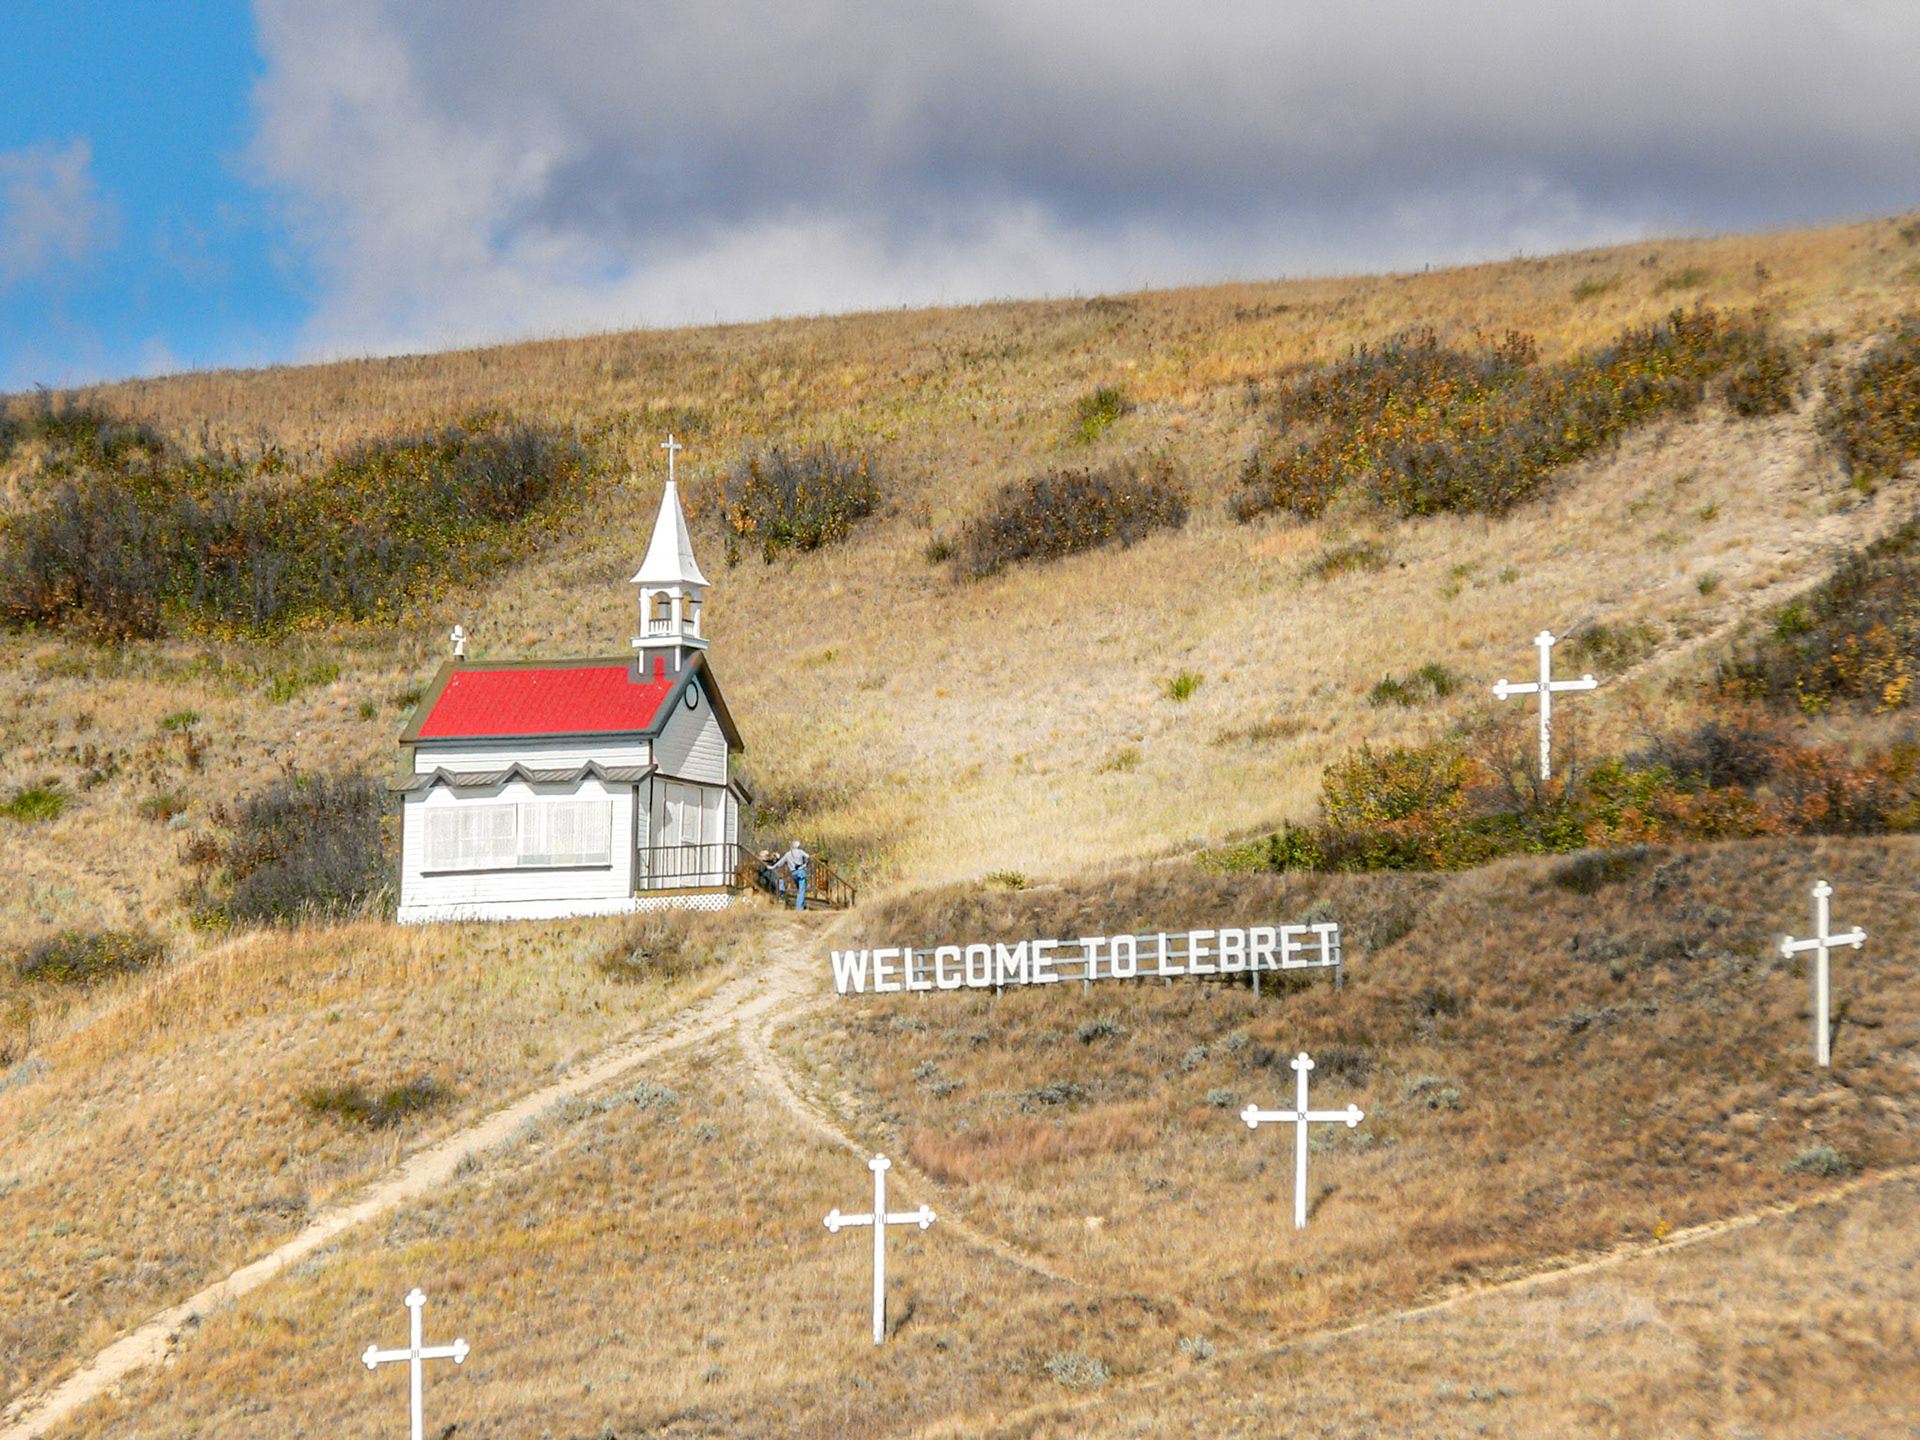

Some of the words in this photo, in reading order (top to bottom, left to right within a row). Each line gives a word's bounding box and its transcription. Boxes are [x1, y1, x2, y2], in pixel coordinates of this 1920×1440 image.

[831, 939, 1058, 994] WELCOME
[1080, 934, 1136, 979] TO
[1158, 923, 1338, 976] LEBRET
